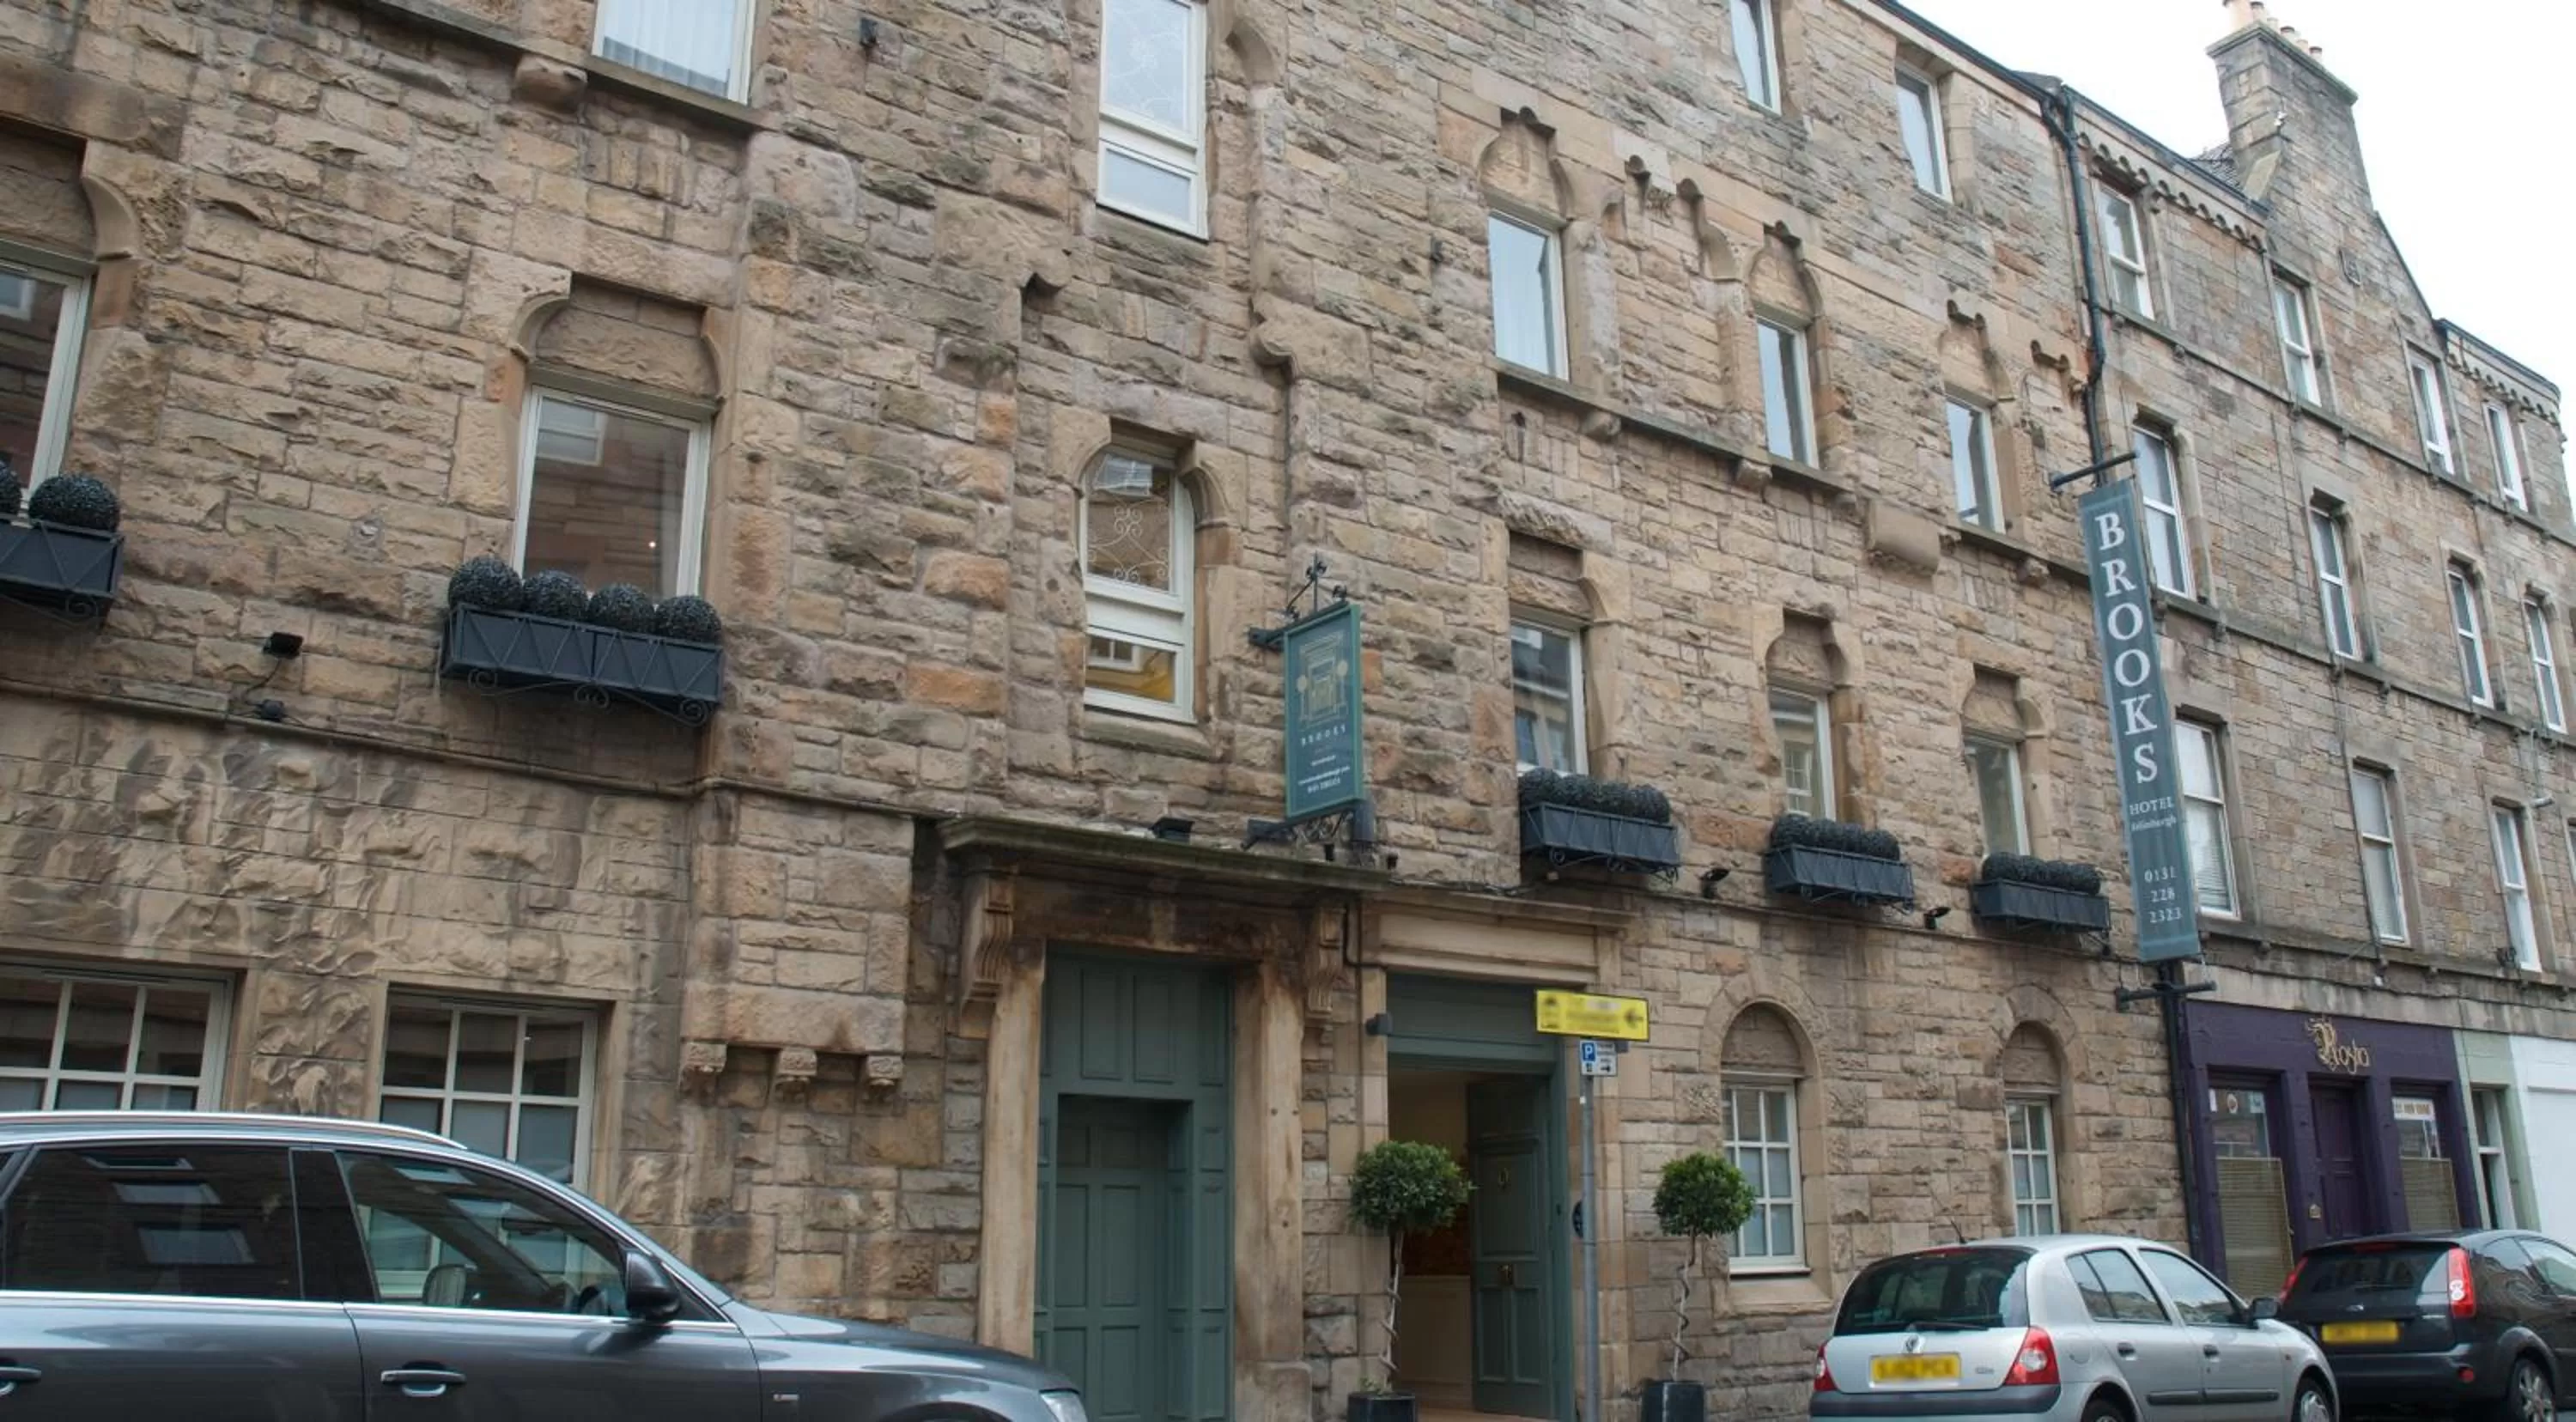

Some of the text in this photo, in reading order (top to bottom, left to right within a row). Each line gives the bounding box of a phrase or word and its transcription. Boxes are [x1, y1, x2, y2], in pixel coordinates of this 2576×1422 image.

[2094, 512, 2158, 784] BROOKS
[2129, 796, 2175, 815] HOTEL
[2144, 866, 2178, 883] 0131
[2150, 886, 2175, 902] 228
[2148, 907, 2182, 923] 2323
[1584, 1044, 1593, 1059] P
